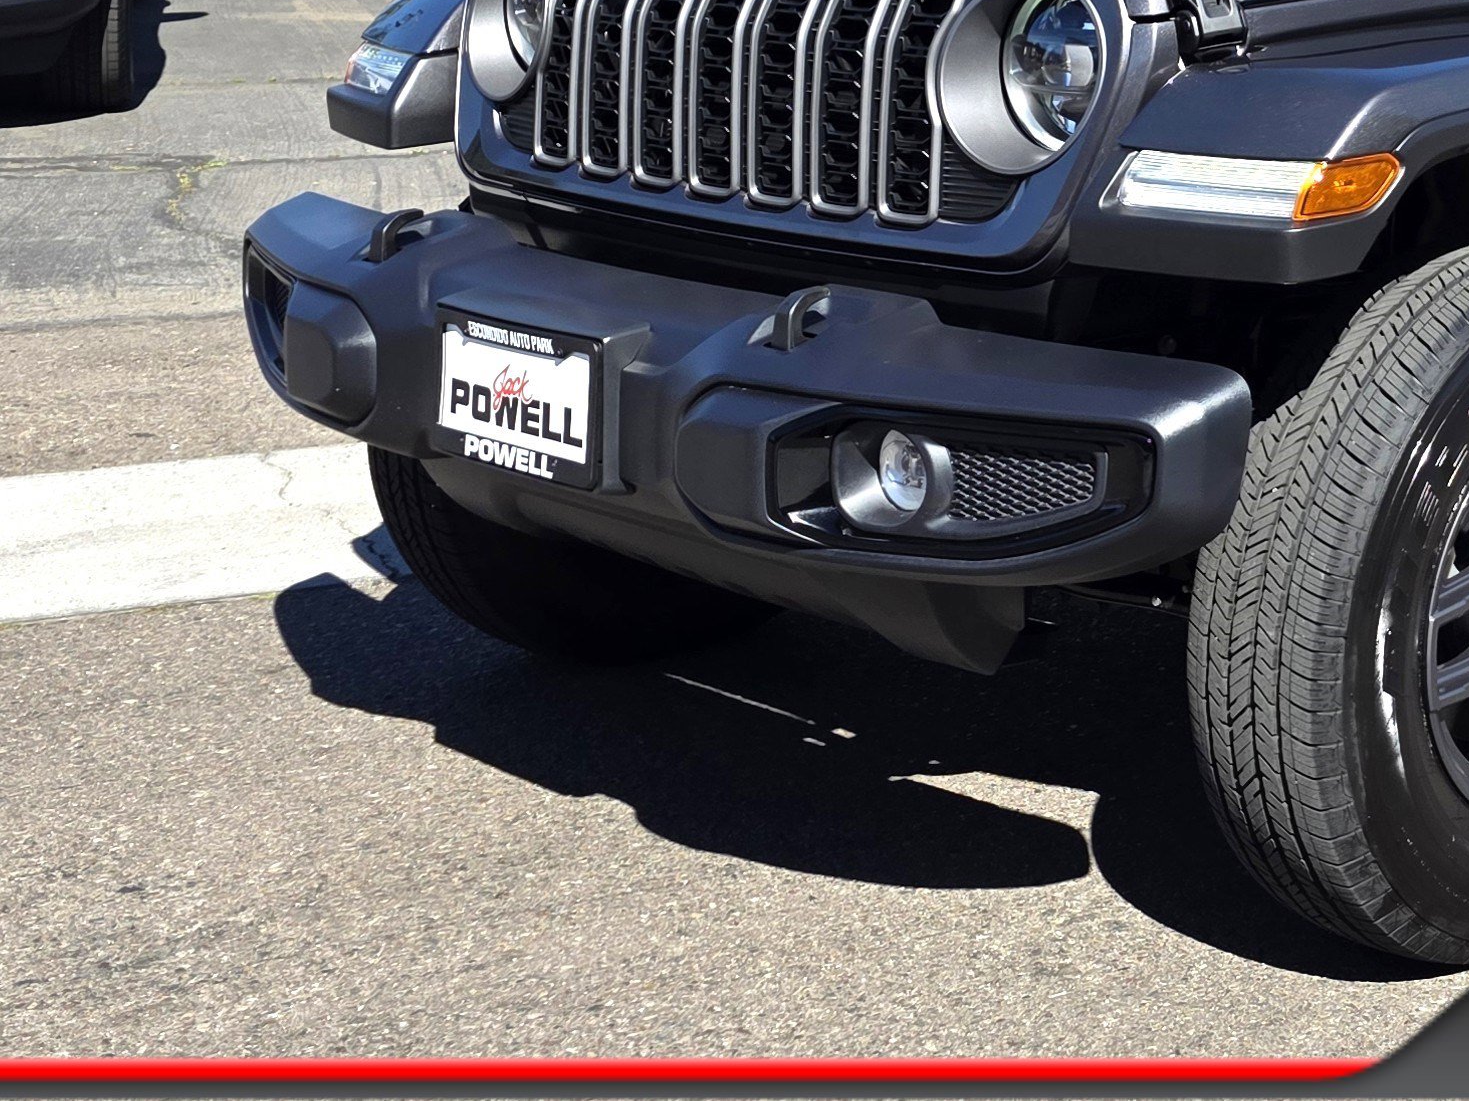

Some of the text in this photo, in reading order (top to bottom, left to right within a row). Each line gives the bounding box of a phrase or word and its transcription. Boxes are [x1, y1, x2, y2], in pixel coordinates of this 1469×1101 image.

[467, 320, 555, 355] ESCONDIDO AUTO PARK
[493, 364, 533, 411] Jack
[450, 377, 583, 449] POWELL
[463, 433, 554, 480] POWELL
